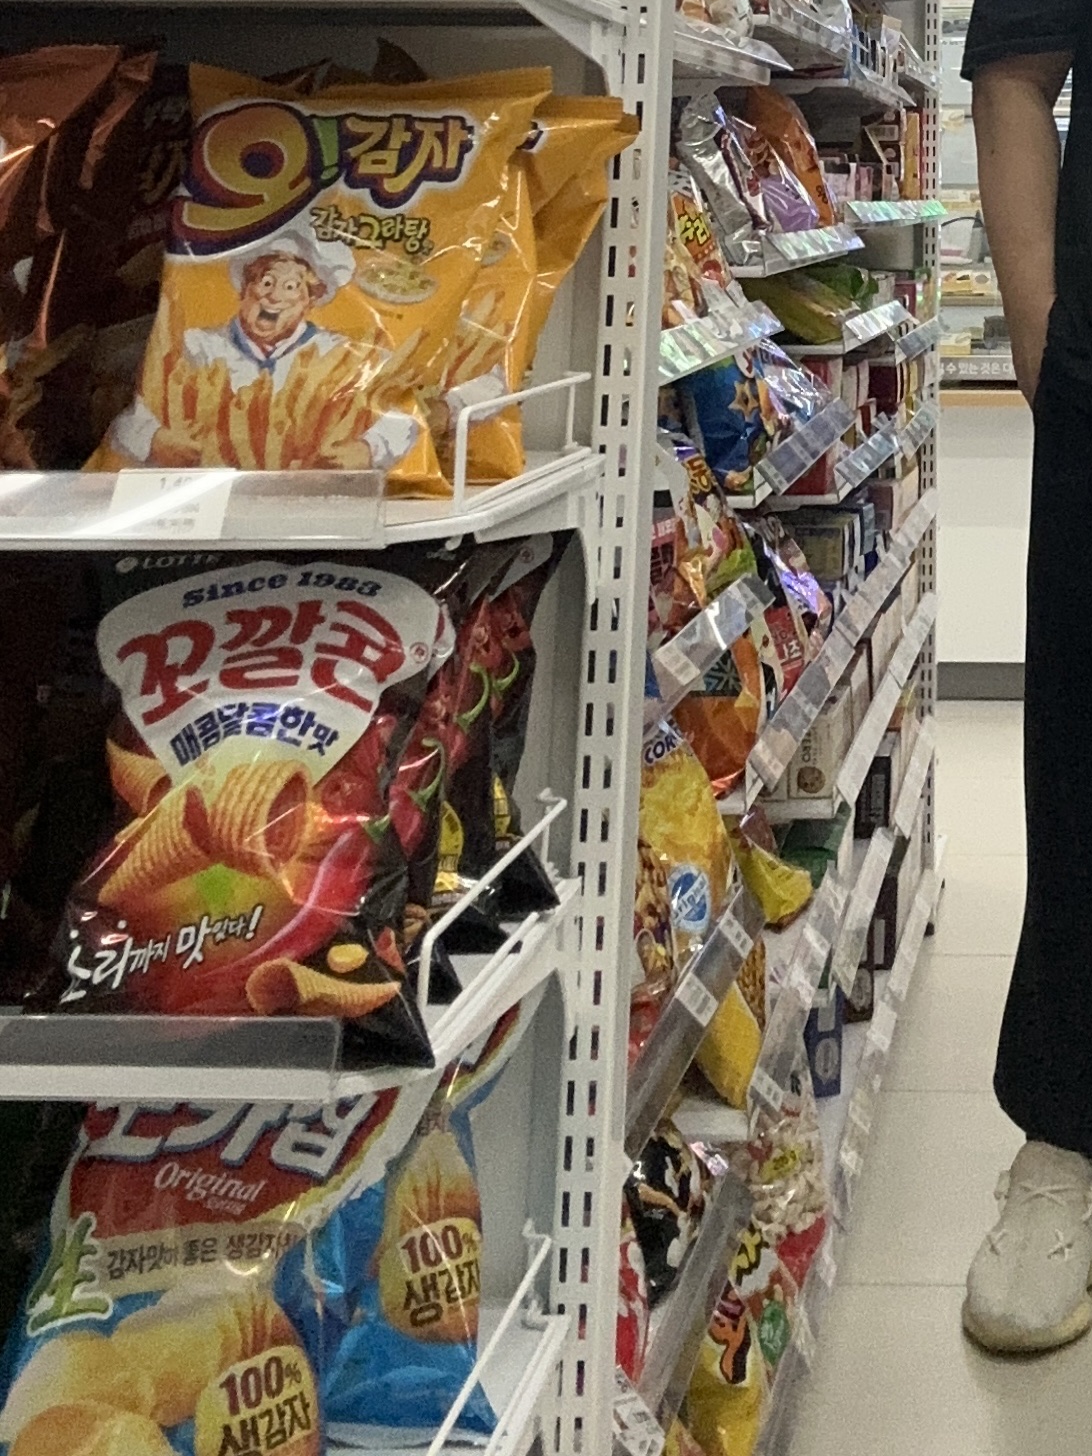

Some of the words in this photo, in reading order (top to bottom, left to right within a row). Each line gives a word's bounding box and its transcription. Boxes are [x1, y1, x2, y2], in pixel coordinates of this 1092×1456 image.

[298, 570, 383, 597] 1983
[115, 600, 407, 726] 꼬깔콘
[175, 905, 264, 970] 맛있다!
[154, 1160, 268, 1204] Original
[400, 1224, 478, 1274] 100%
[219, 1355, 302, 1417] 100%
[217, 1391, 311, 1456] 생감자
